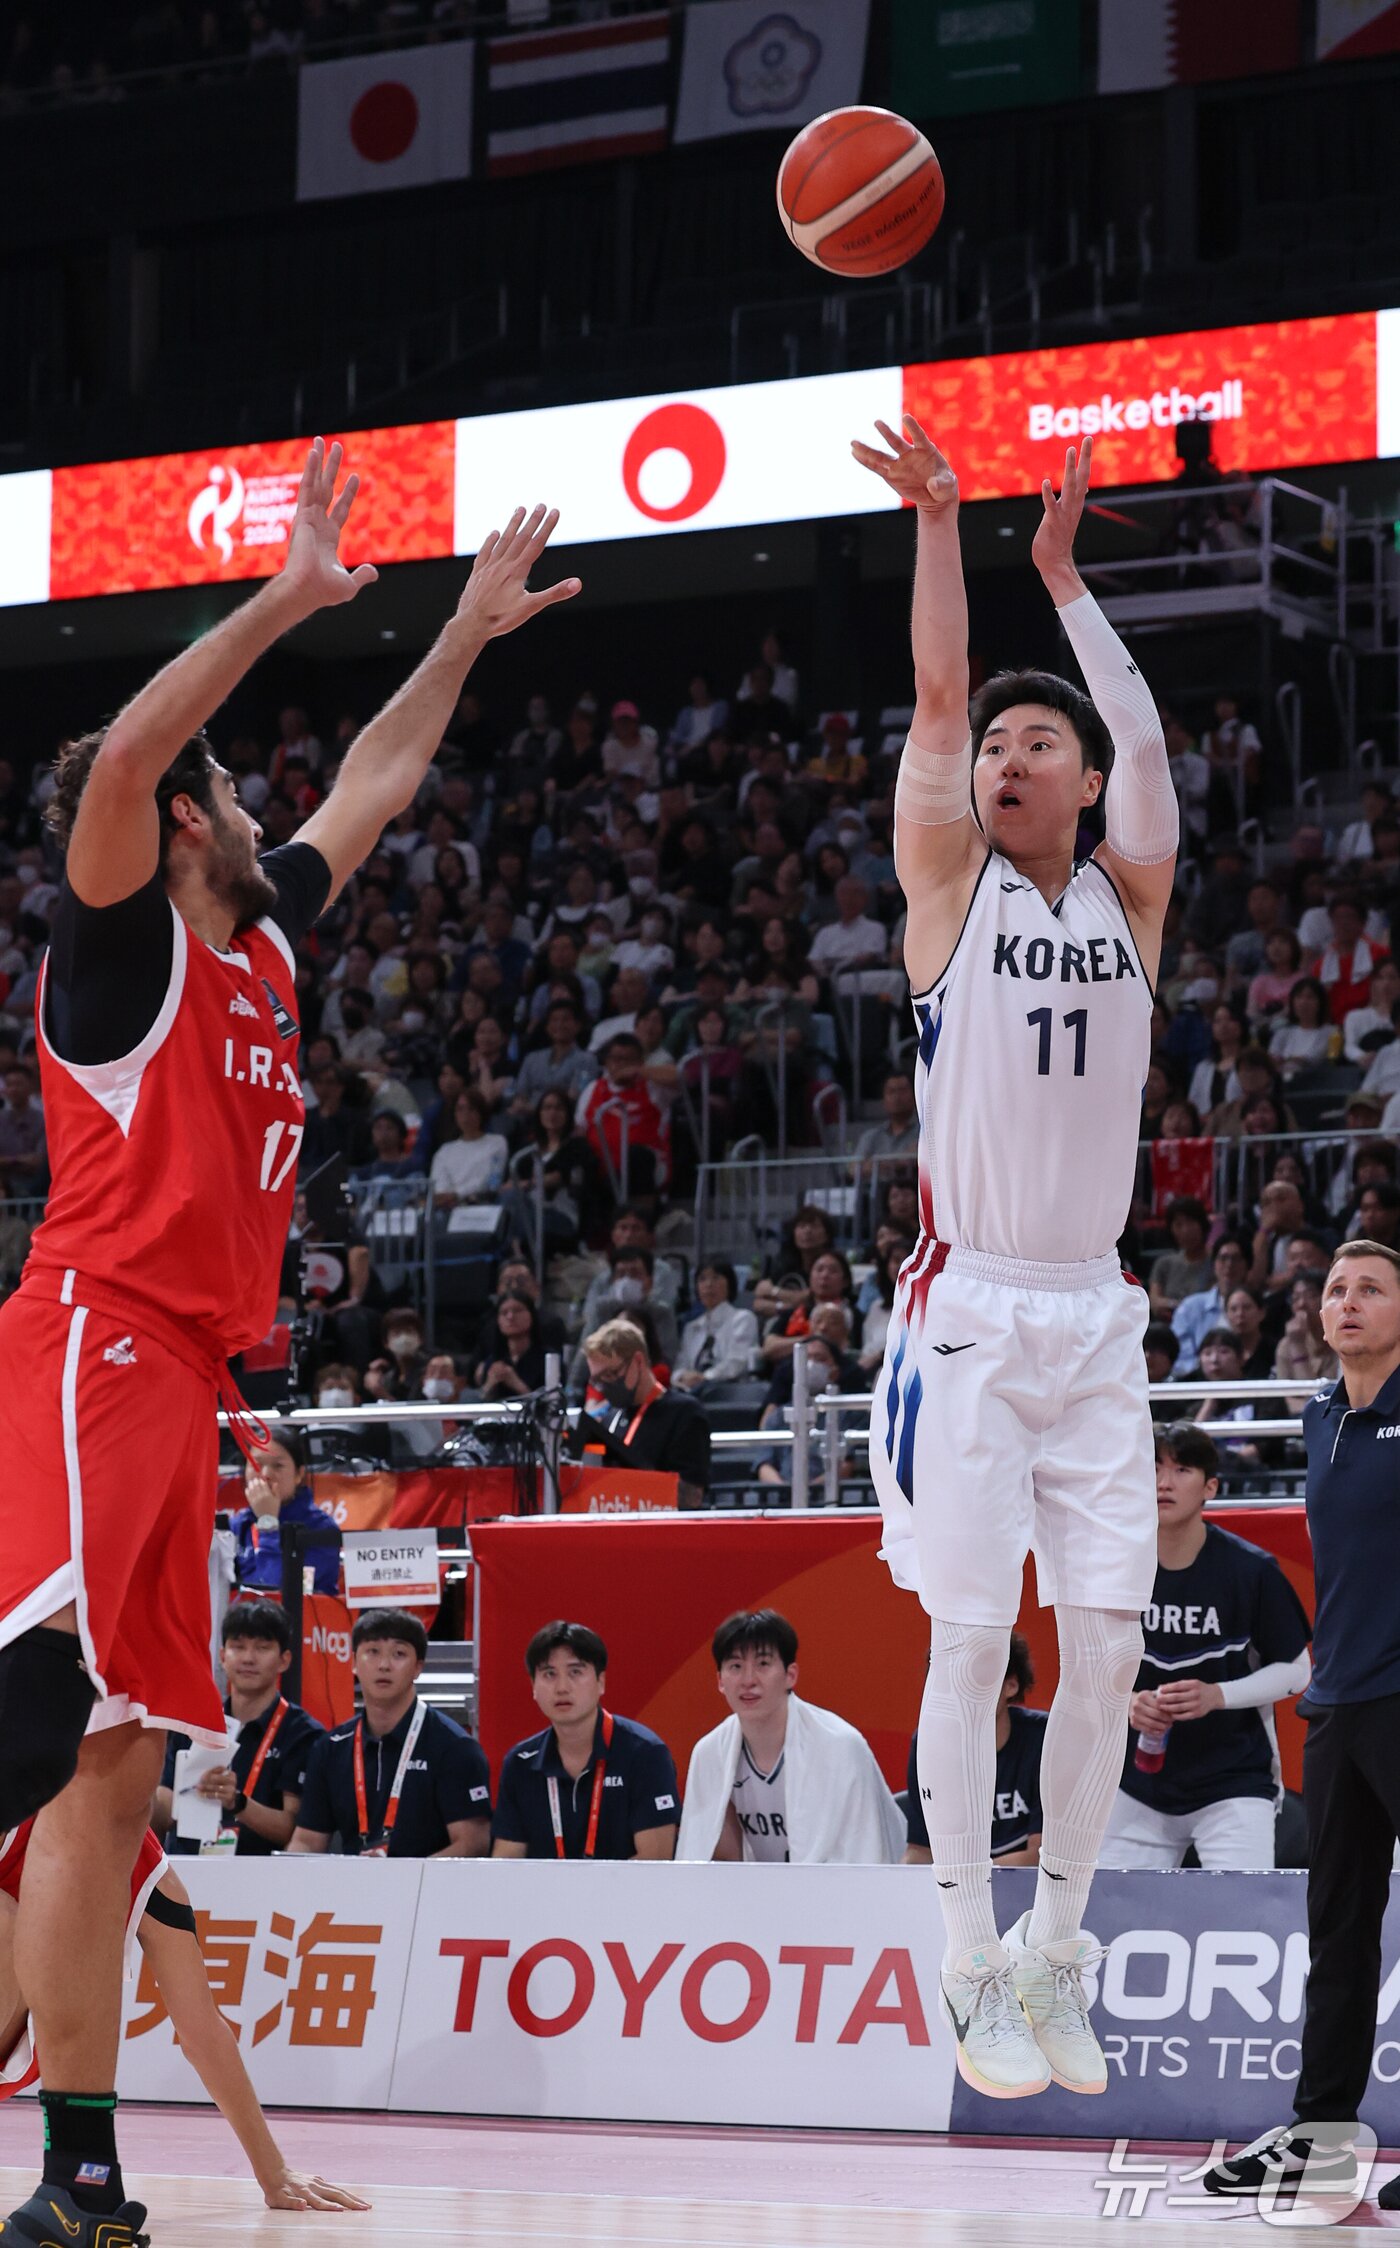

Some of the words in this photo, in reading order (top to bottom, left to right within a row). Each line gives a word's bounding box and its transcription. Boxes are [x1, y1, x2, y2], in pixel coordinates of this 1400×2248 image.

[1029, 379, 1243, 441] Basketball
[993, 933, 1137, 983] KOREA
[1026, 1007, 1088, 1077] 11
[259, 1120, 304, 1193] 17
[318, 1500, 348, 1525] 26
[357, 1549, 377, 1562] NO
[381, 1547, 424, 1561] ENTRY
[1143, 1603, 1221, 1636] OREA
[303, 1625, 351, 1663] -Nag
[603, 1775, 624, 1787] REA
[993, 1789, 1030, 1821] EA
[125, 1910, 384, 2048] 東海
[439, 1937, 932, 2047] TOYOTA
[1104, 2034, 1191, 2078] RTS
[79, 2163, 106, 2177] LP
